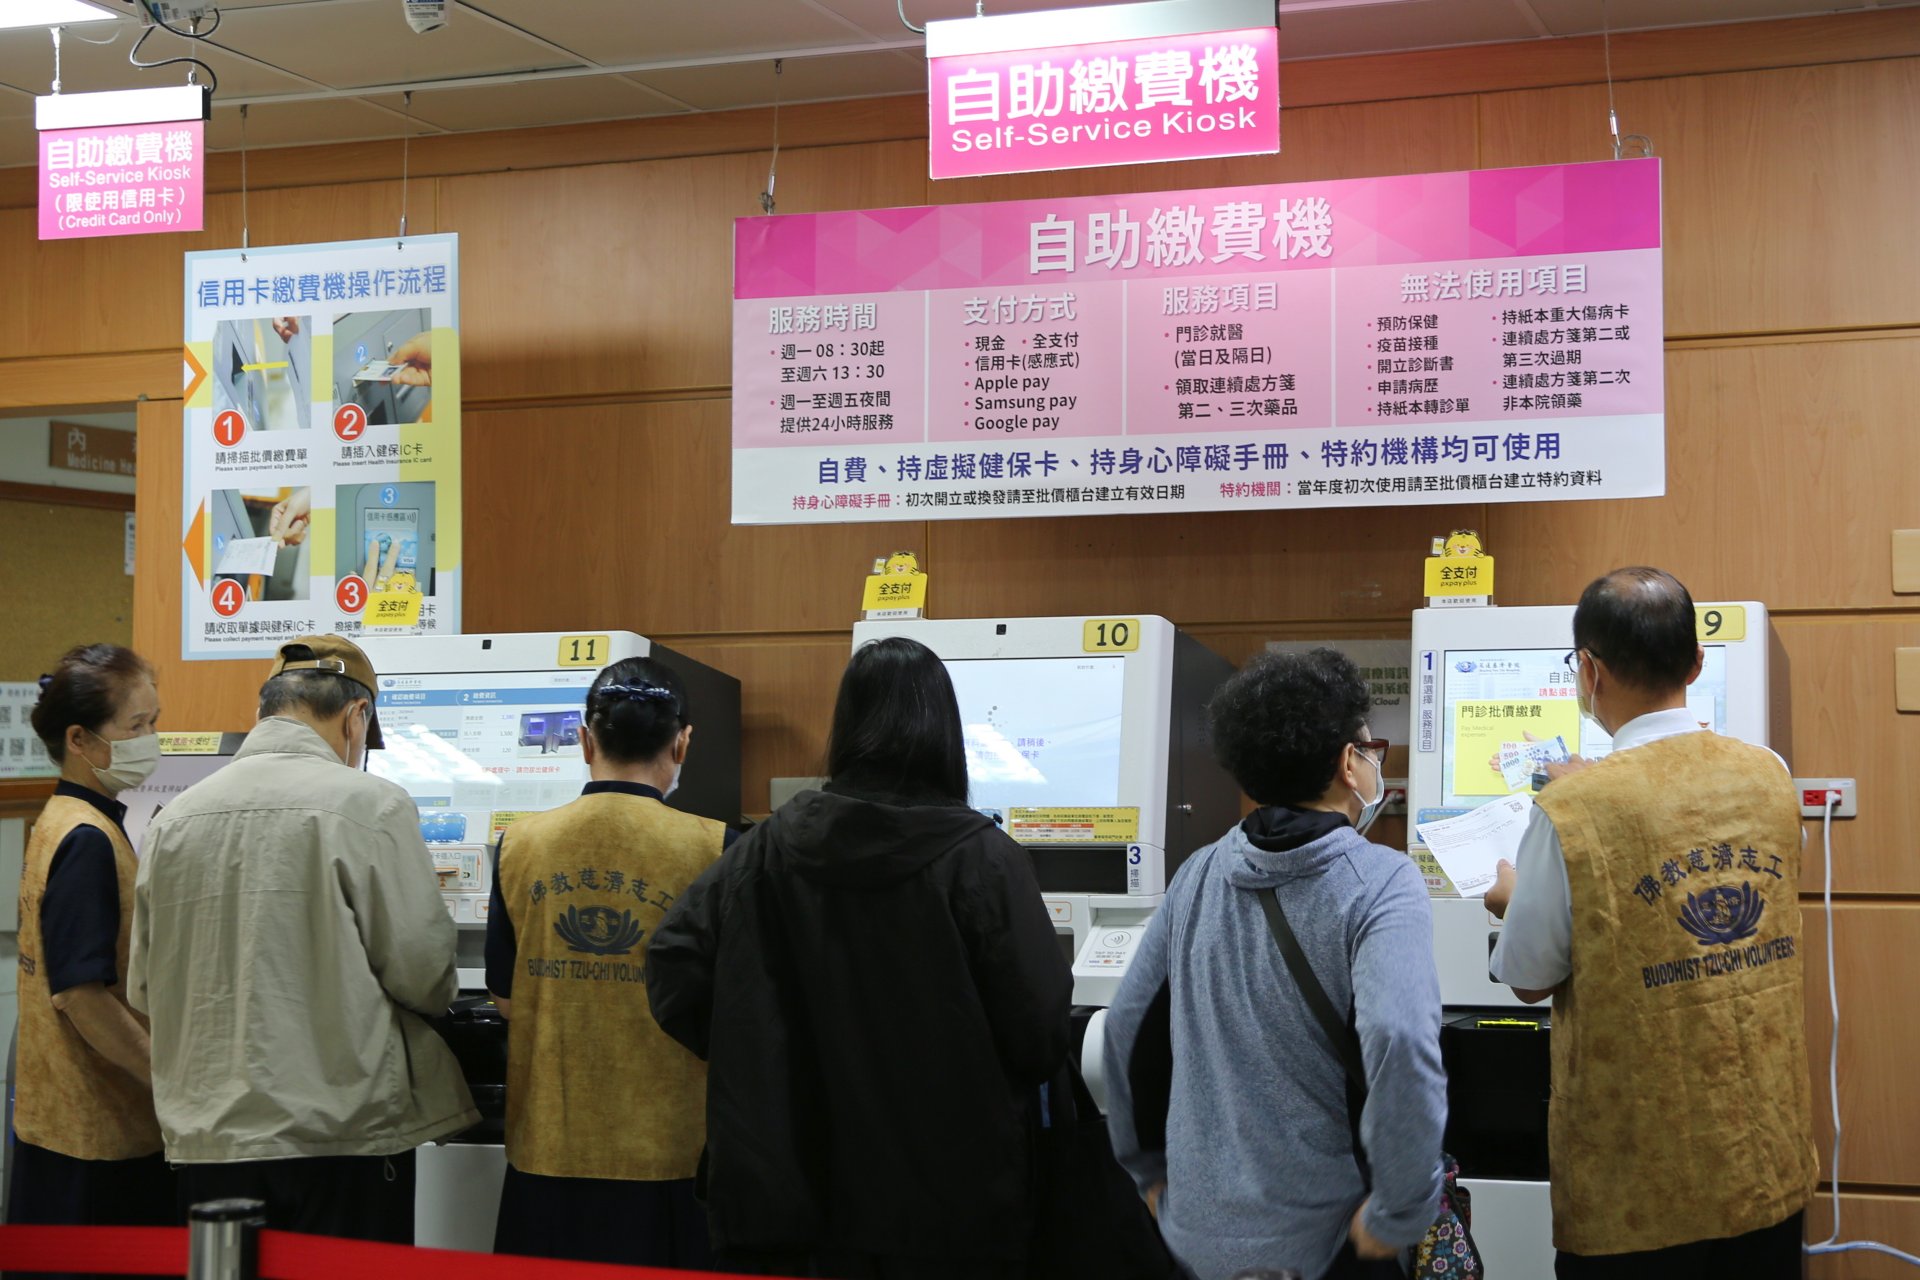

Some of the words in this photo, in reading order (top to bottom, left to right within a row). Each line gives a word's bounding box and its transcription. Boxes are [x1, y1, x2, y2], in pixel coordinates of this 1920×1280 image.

[946, 44, 1260, 126] 自助繳費機
[951, 118, 1152, 152] Self-Service
[1163, 106, 1257, 135] Kiosk
[47, 130, 193, 171] 自助繳費機
[49, 169, 144, 188] Self-Service
[147, 165, 191, 182] Kiosk
[109, 211, 141, 226] Card
[1030, 197, 1334, 275] 自助繳費機
[197, 264, 446, 309] 信用卡繳費機操作流程
[1400, 263, 1588, 303] 無法使用項目
[1161, 281, 1279, 316] 服務項目
[768, 302, 878, 335] 服務時間
[963, 293, 1077, 326] 支付方式
[1502, 303, 1630, 326] 持紙本重大傷病卡
[1175, 323, 1244, 343] 門診就醫
[1376, 314, 1439, 333] 預防保健
[974, 335, 1006, 351] 現金
[1032, 331, 1079, 349] 全支付
[1376, 335, 1439, 353] 疫苗接種
[1502, 324, 1630, 347] 連續處方箋第二或
[974, 351, 1081, 372] 信用卡(感應式)
[1174, 346, 1273, 369] (當日及隔日)
[1377, 355, 1454, 375] 開立診斷書
[1502, 349, 1582, 369] 第三次過期
[974, 374, 1018, 393] Apple
[1022, 375, 1050, 392] pay
[1175, 374, 1296, 396] 領取連續處方箋
[1377, 377, 1439, 396] 申請病歷
[1502, 368, 1631, 390] 連續處方箋第二次
[780, 390, 891, 411] 週一至週五夜間
[974, 395, 1046, 412] Samsung
[1049, 394, 1077, 411] pay
[1177, 398, 1298, 420] 第二、三次藥品
[1377, 397, 1470, 417] 持紙本轉診單
[1502, 392, 1583, 412] 非本院領藥
[222, 415, 233, 441] 1
[342, 409, 358, 436] 2
[780, 413, 894, 434] 提供24小時服務
[974, 414, 1028, 433] Google
[1032, 415, 1060, 431] pay
[215, 448, 308, 464] 請掃描批價繳費單
[341, 443, 423, 460] 請插入健保IC卡
[249, 464, 273, 472] payment
[285, 462, 308, 470] barcode
[383, 487, 393, 505] 3
[1440, 565, 1478, 580] 全支付
[218, 585, 236, 611] 4
[343, 582, 360, 608] 3
[879, 582, 912, 595] 全支付
[378, 599, 409, 612] 全支付
[204, 619, 317, 636] 請收取單據與健保IC卡
[1704, 610, 1723, 636] 9
[241, 635, 265, 643] payment
[1096, 622, 1129, 647] 10
[570, 638, 596, 662] 11
[1423, 652, 1433, 671] 1
[1461, 704, 1542, 719] 門診批價繳費
[1128, 845, 1141, 865] 3
[1632, 842, 1784, 907] 佛教慈濟志工
[1641, 956, 1702, 990] BUDDHIST
